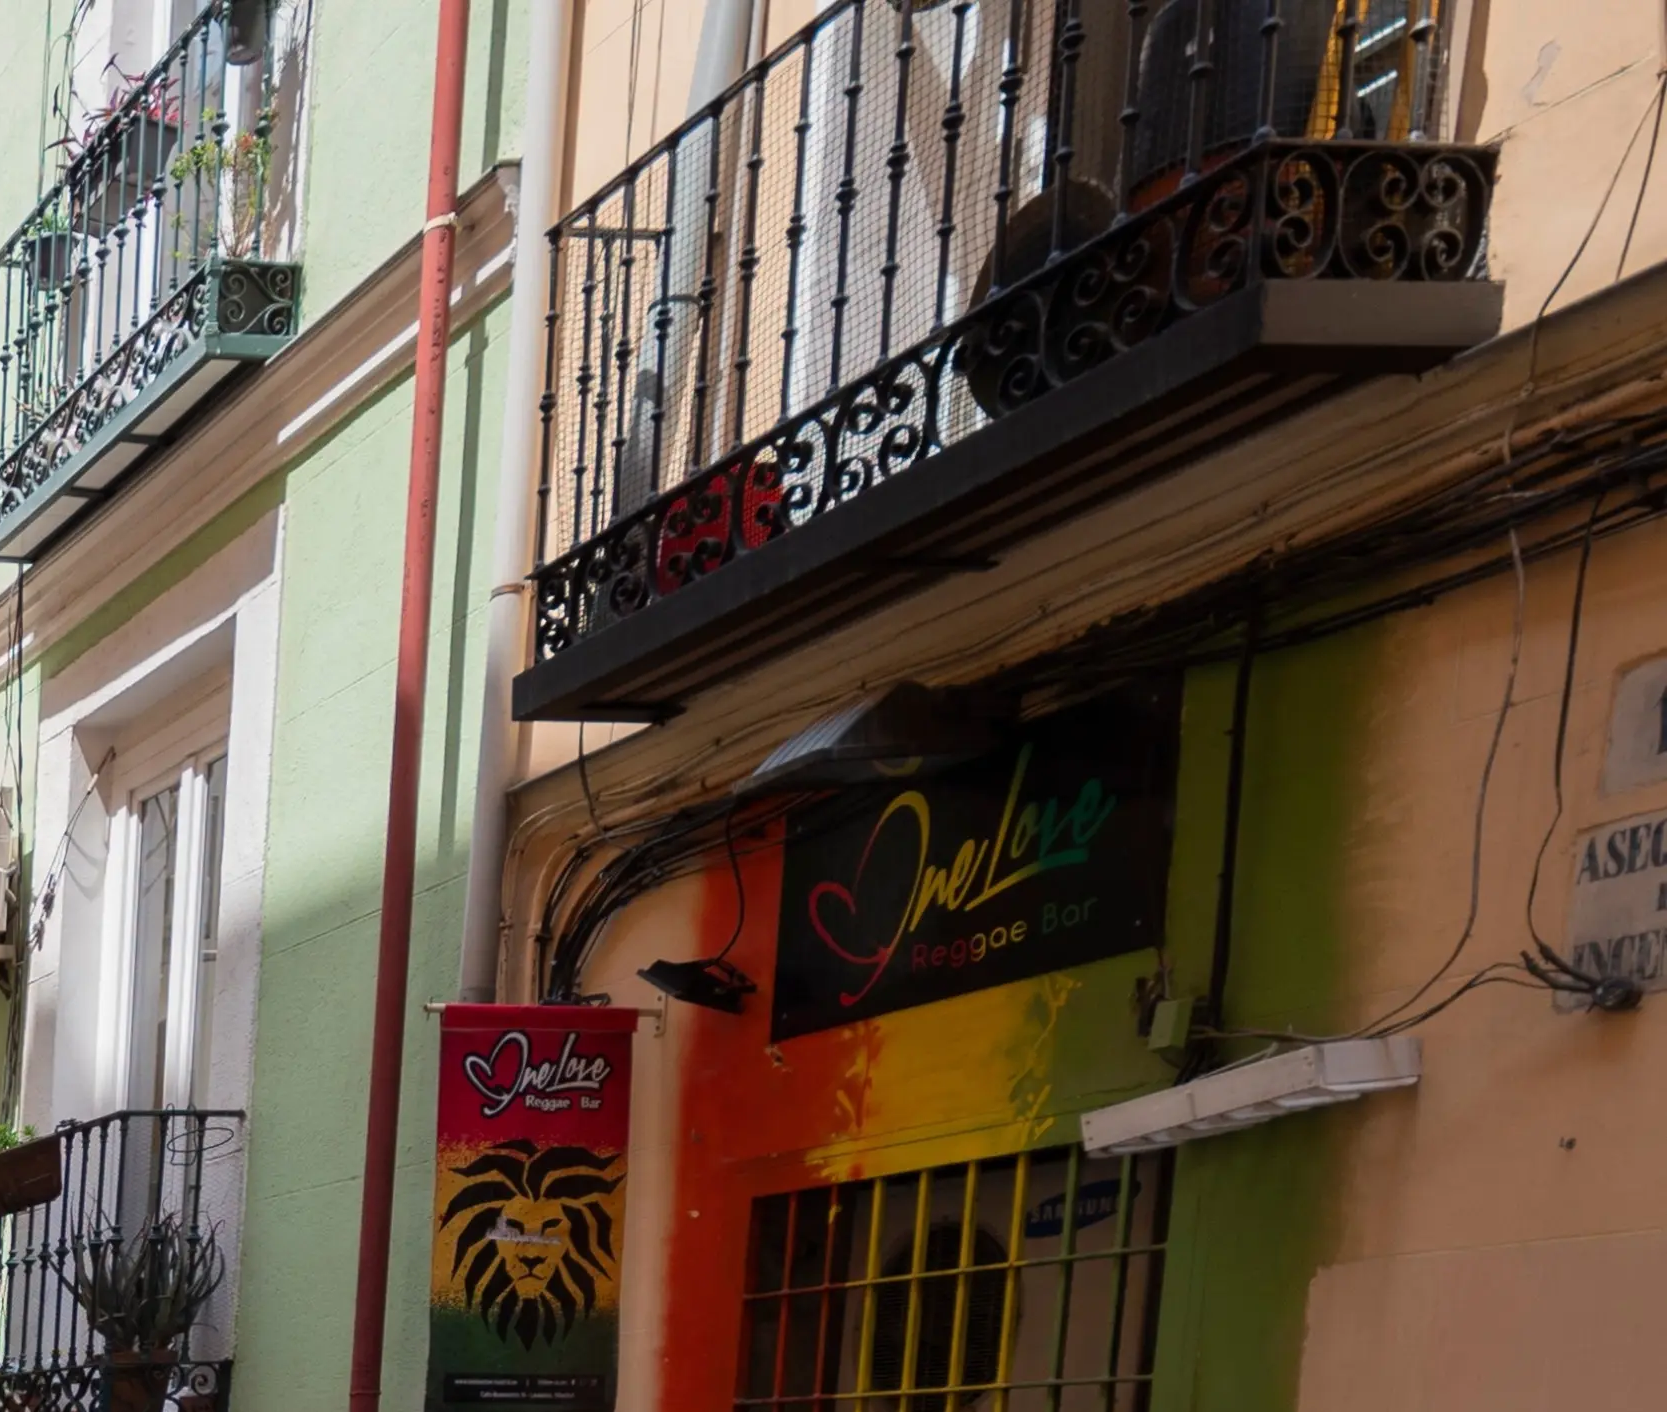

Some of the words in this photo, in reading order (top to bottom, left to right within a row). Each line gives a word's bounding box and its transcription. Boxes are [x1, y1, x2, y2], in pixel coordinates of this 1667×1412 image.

[910, 919, 1028, 973] Reggae
[1041, 897, 1099, 935] Bar
[525, 1095, 571, 1111] Reggae
[580, 1096, 602, 1109] Bar
